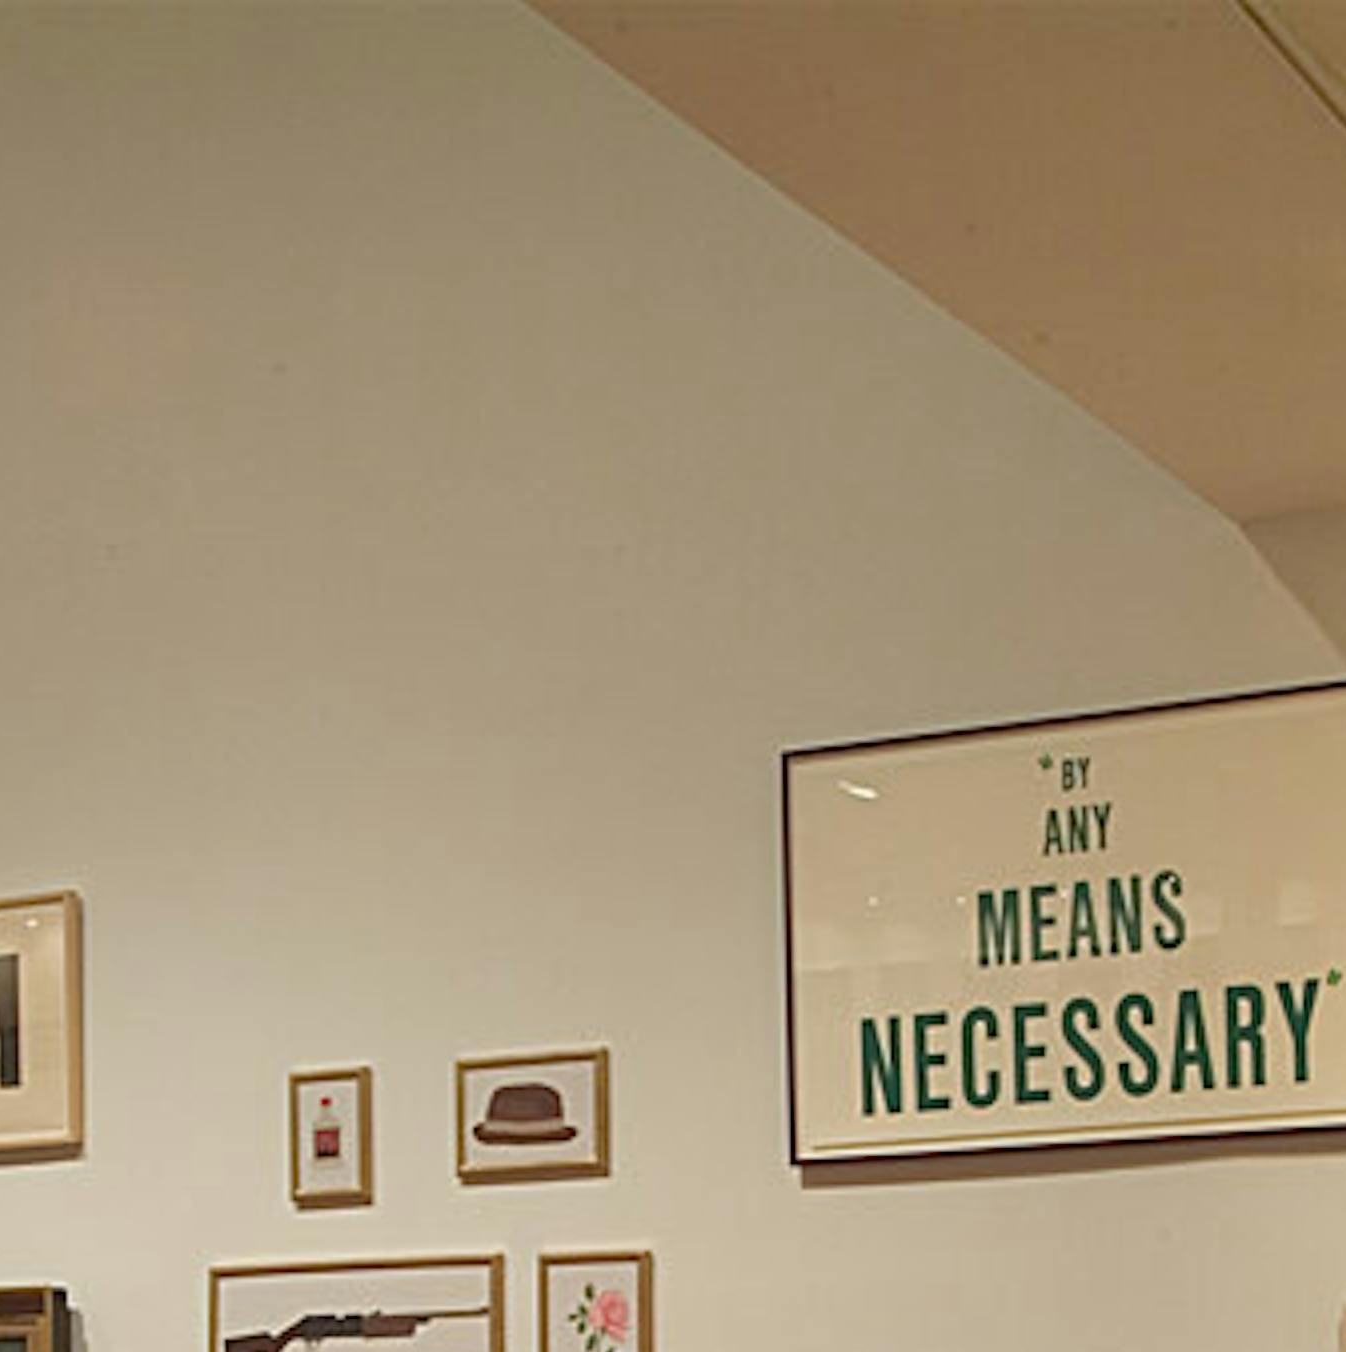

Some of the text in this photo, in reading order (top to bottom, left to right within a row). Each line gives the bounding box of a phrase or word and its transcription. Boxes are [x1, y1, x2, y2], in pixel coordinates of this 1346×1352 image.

[1062, 757, 1090, 792] BY
[1042, 802, 1111, 857] ANY
[977, 870, 1187, 966] MEANS
[861, 978, 1320, 1117] NECESSARY
